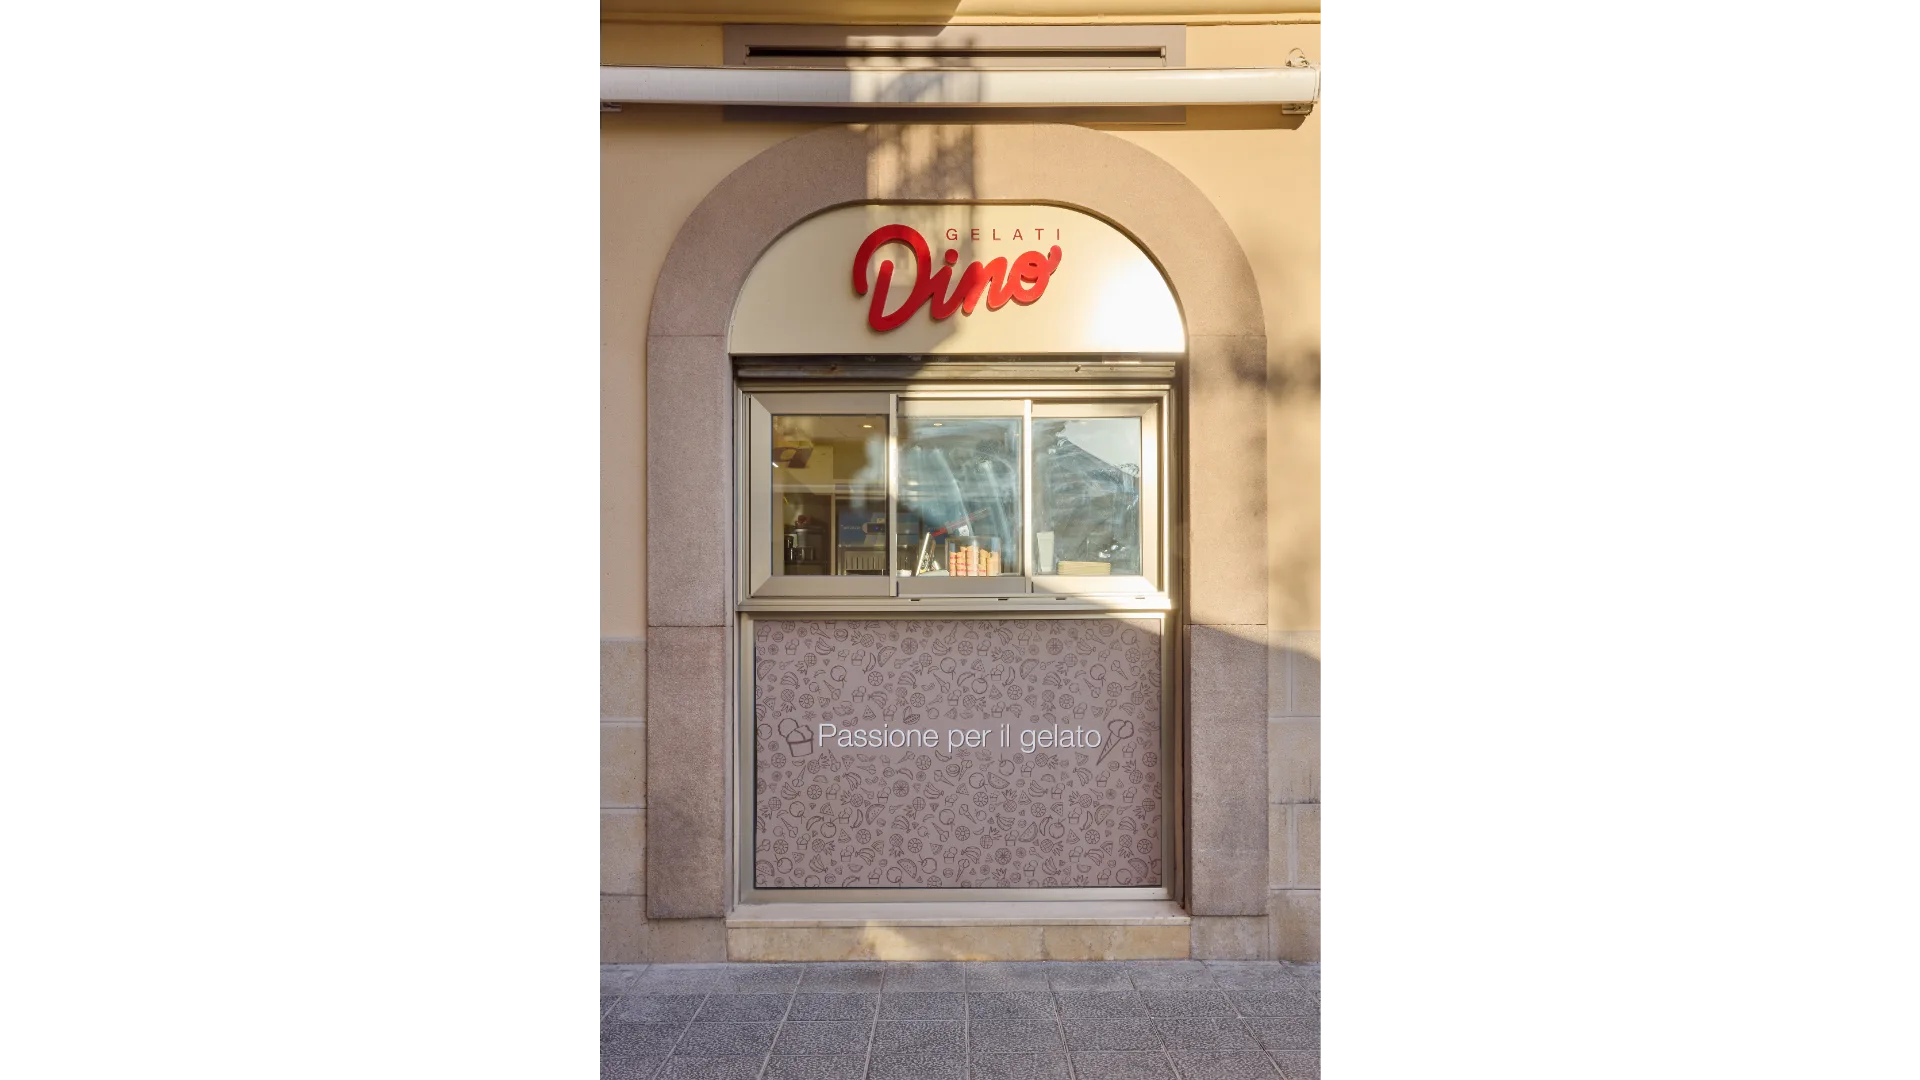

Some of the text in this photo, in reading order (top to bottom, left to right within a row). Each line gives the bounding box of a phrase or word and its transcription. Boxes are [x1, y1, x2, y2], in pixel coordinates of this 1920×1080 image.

[946, 228, 1061, 241] GELATI
[853, 223, 1062, 331] Dino
[818, 723, 1101, 753] Passione per il gelato
